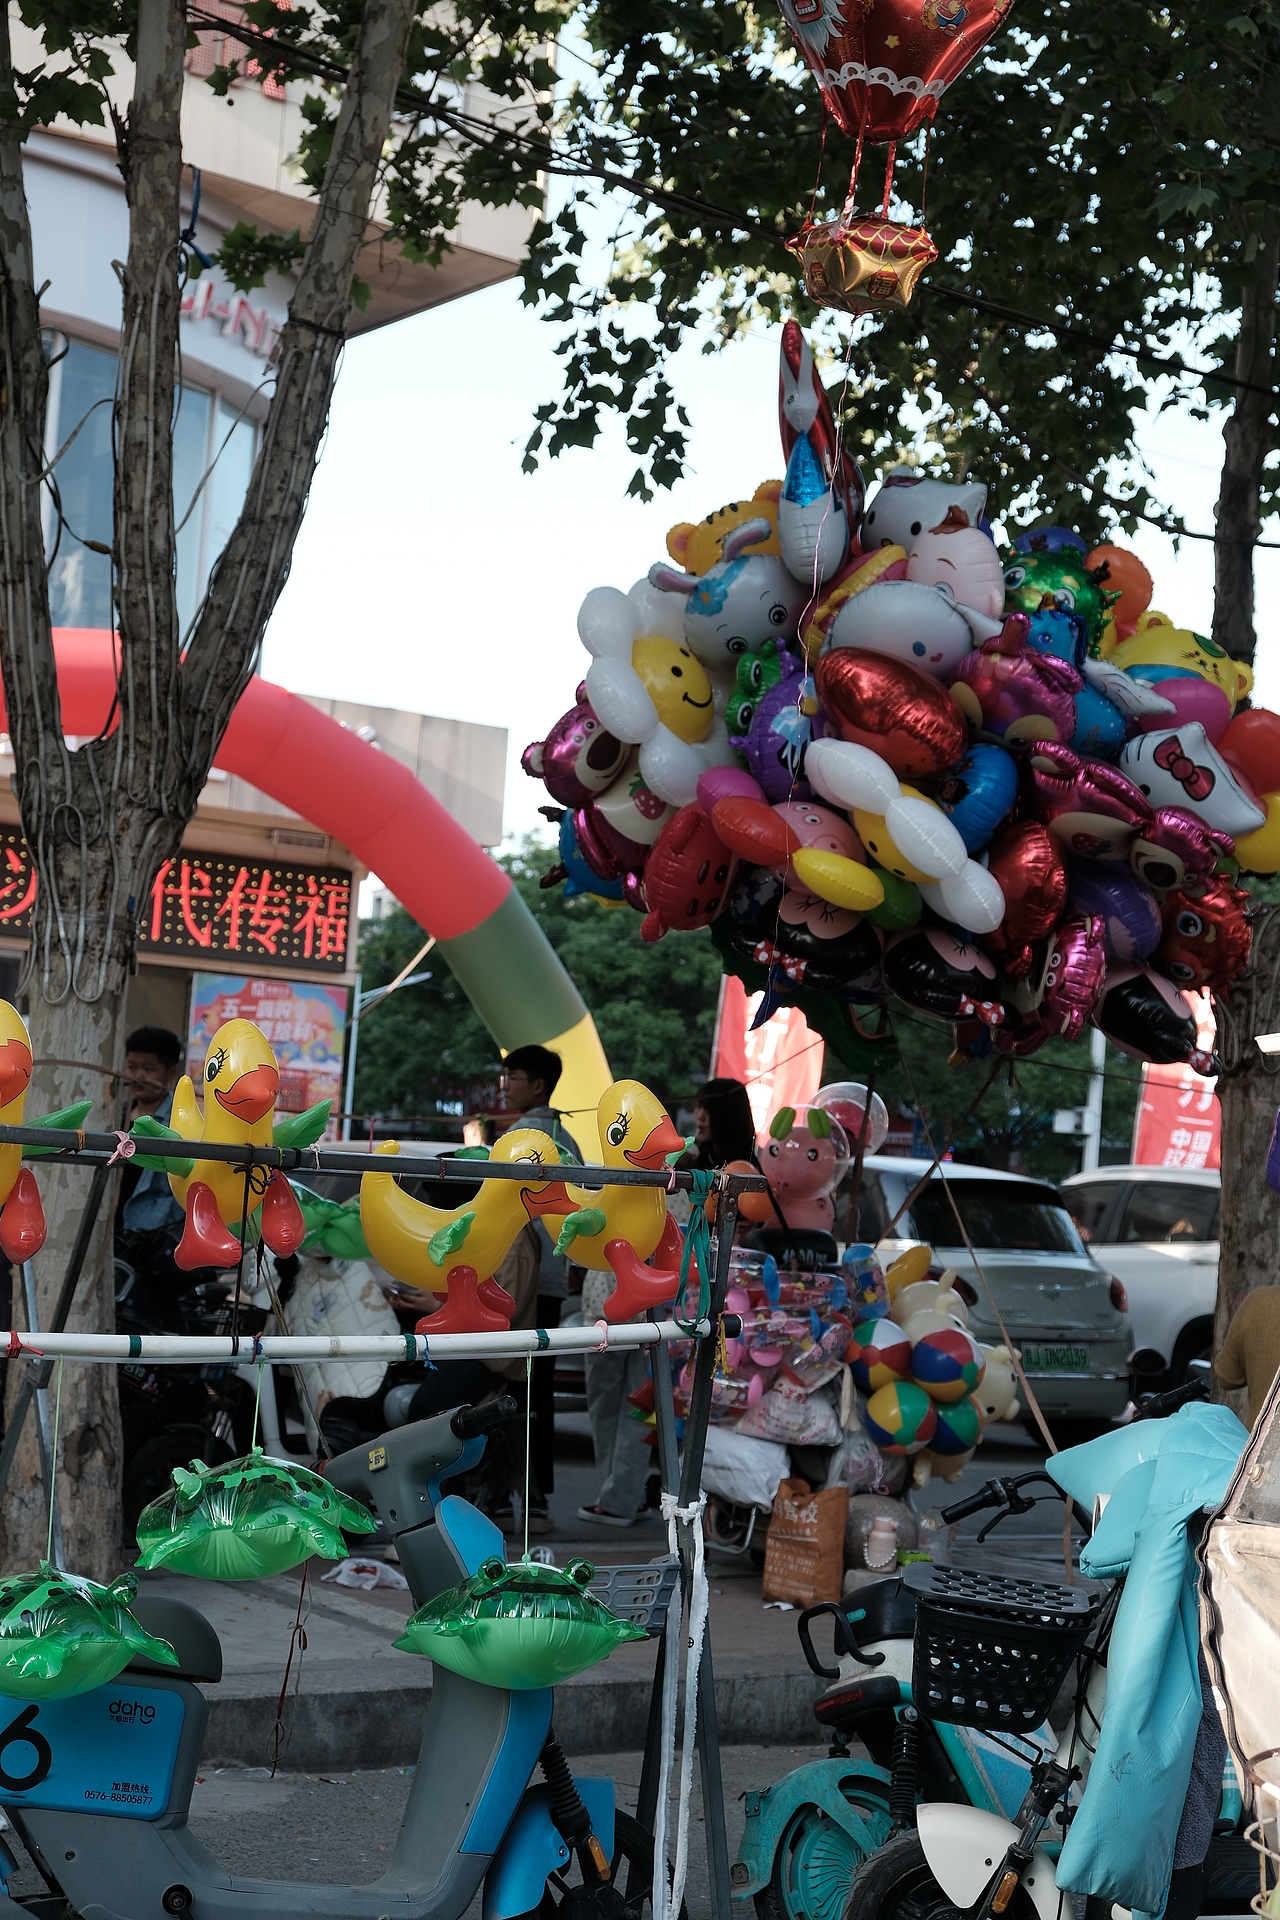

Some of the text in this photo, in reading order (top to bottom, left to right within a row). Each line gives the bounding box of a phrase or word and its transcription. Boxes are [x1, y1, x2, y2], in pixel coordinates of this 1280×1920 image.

[872, 277, 894, 295] 福
[151, 859, 349, 957] 代传福
[1169, 1127, 1214, 1153] 中国
[0, 1704, 52, 1792] 6
[84, 1790, 153, 1805] 0576-88505877
